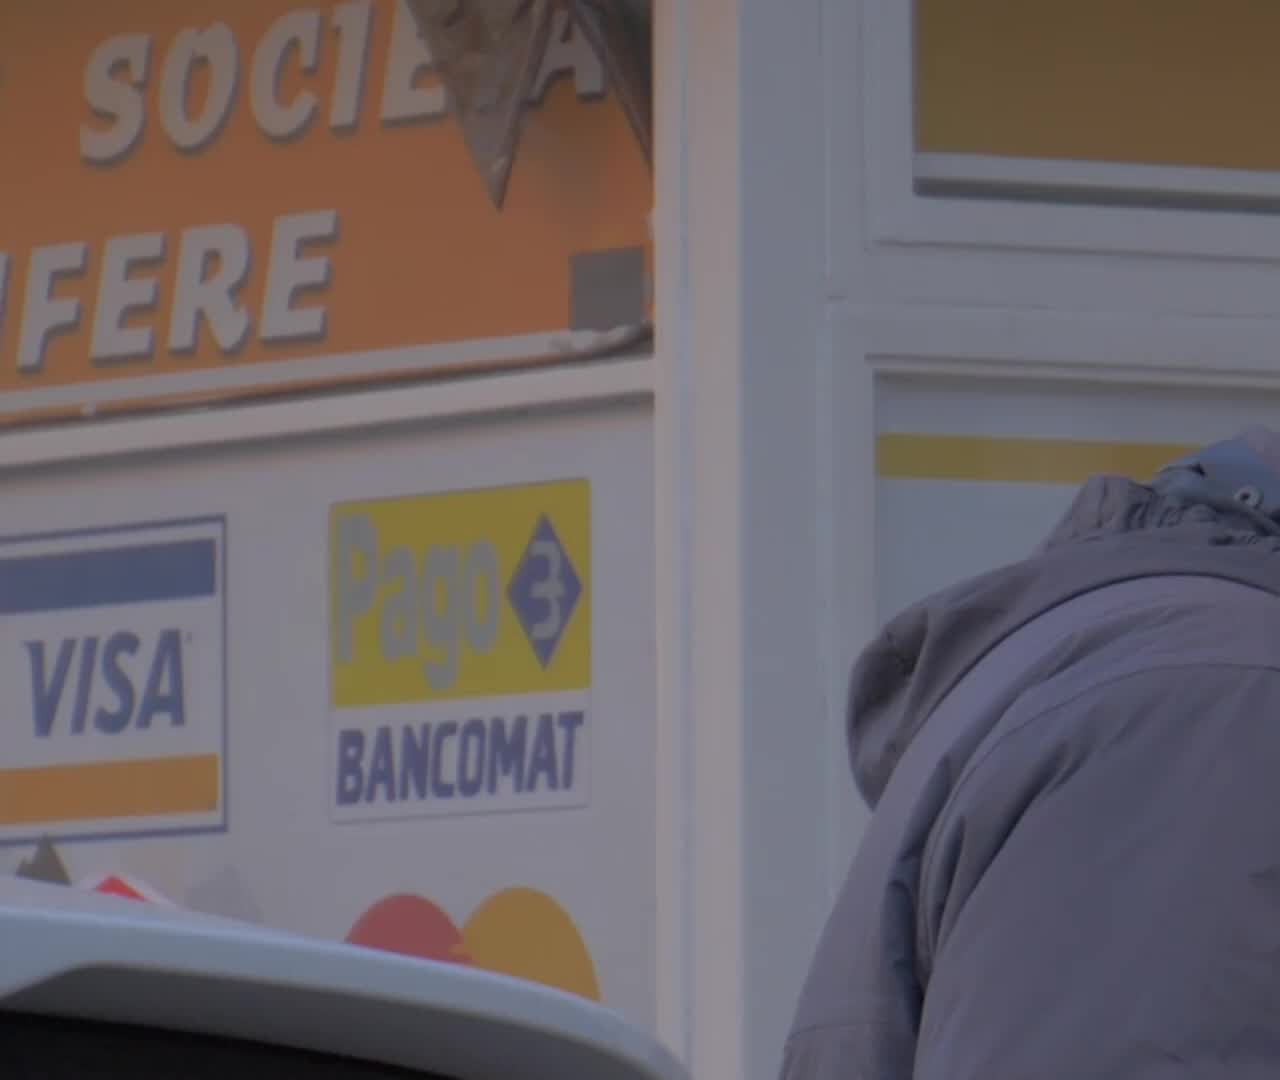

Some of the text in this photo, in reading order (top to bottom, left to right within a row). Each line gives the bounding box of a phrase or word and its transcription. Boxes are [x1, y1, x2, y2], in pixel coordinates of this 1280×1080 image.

[334, 512, 501, 692] Pago
[24, 628, 188, 738] VISA
[335, 711, 585, 806] BANCOMAT
